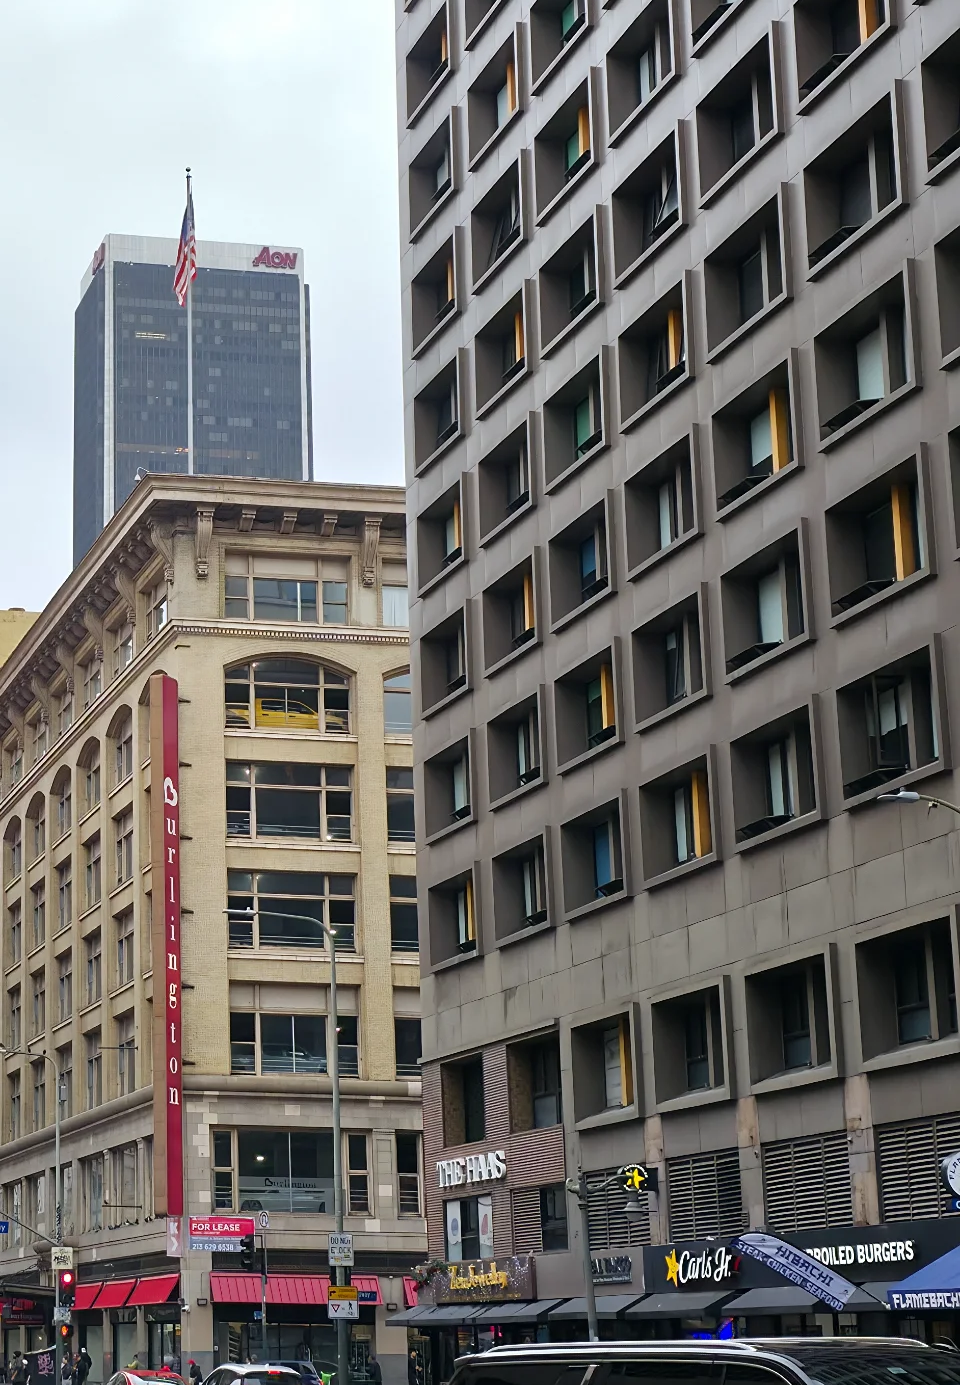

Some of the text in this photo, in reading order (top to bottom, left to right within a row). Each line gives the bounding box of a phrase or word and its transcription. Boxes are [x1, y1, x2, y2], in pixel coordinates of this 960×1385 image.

[163, 777, 180, 1106] Burlington
[437, 1151, 506, 1187] THE HAAS
[192, 1223, 210, 1231] FOR
[679, 1247, 733, 1284] Carl's Jr.
[776, 1246, 834, 1287] HIBACHI
[857, 1240, 914, 1264] BURGERS
[767, 1259, 804, 1285] CHICKEN
[804, 1283, 845, 1311] SEAFOOD
